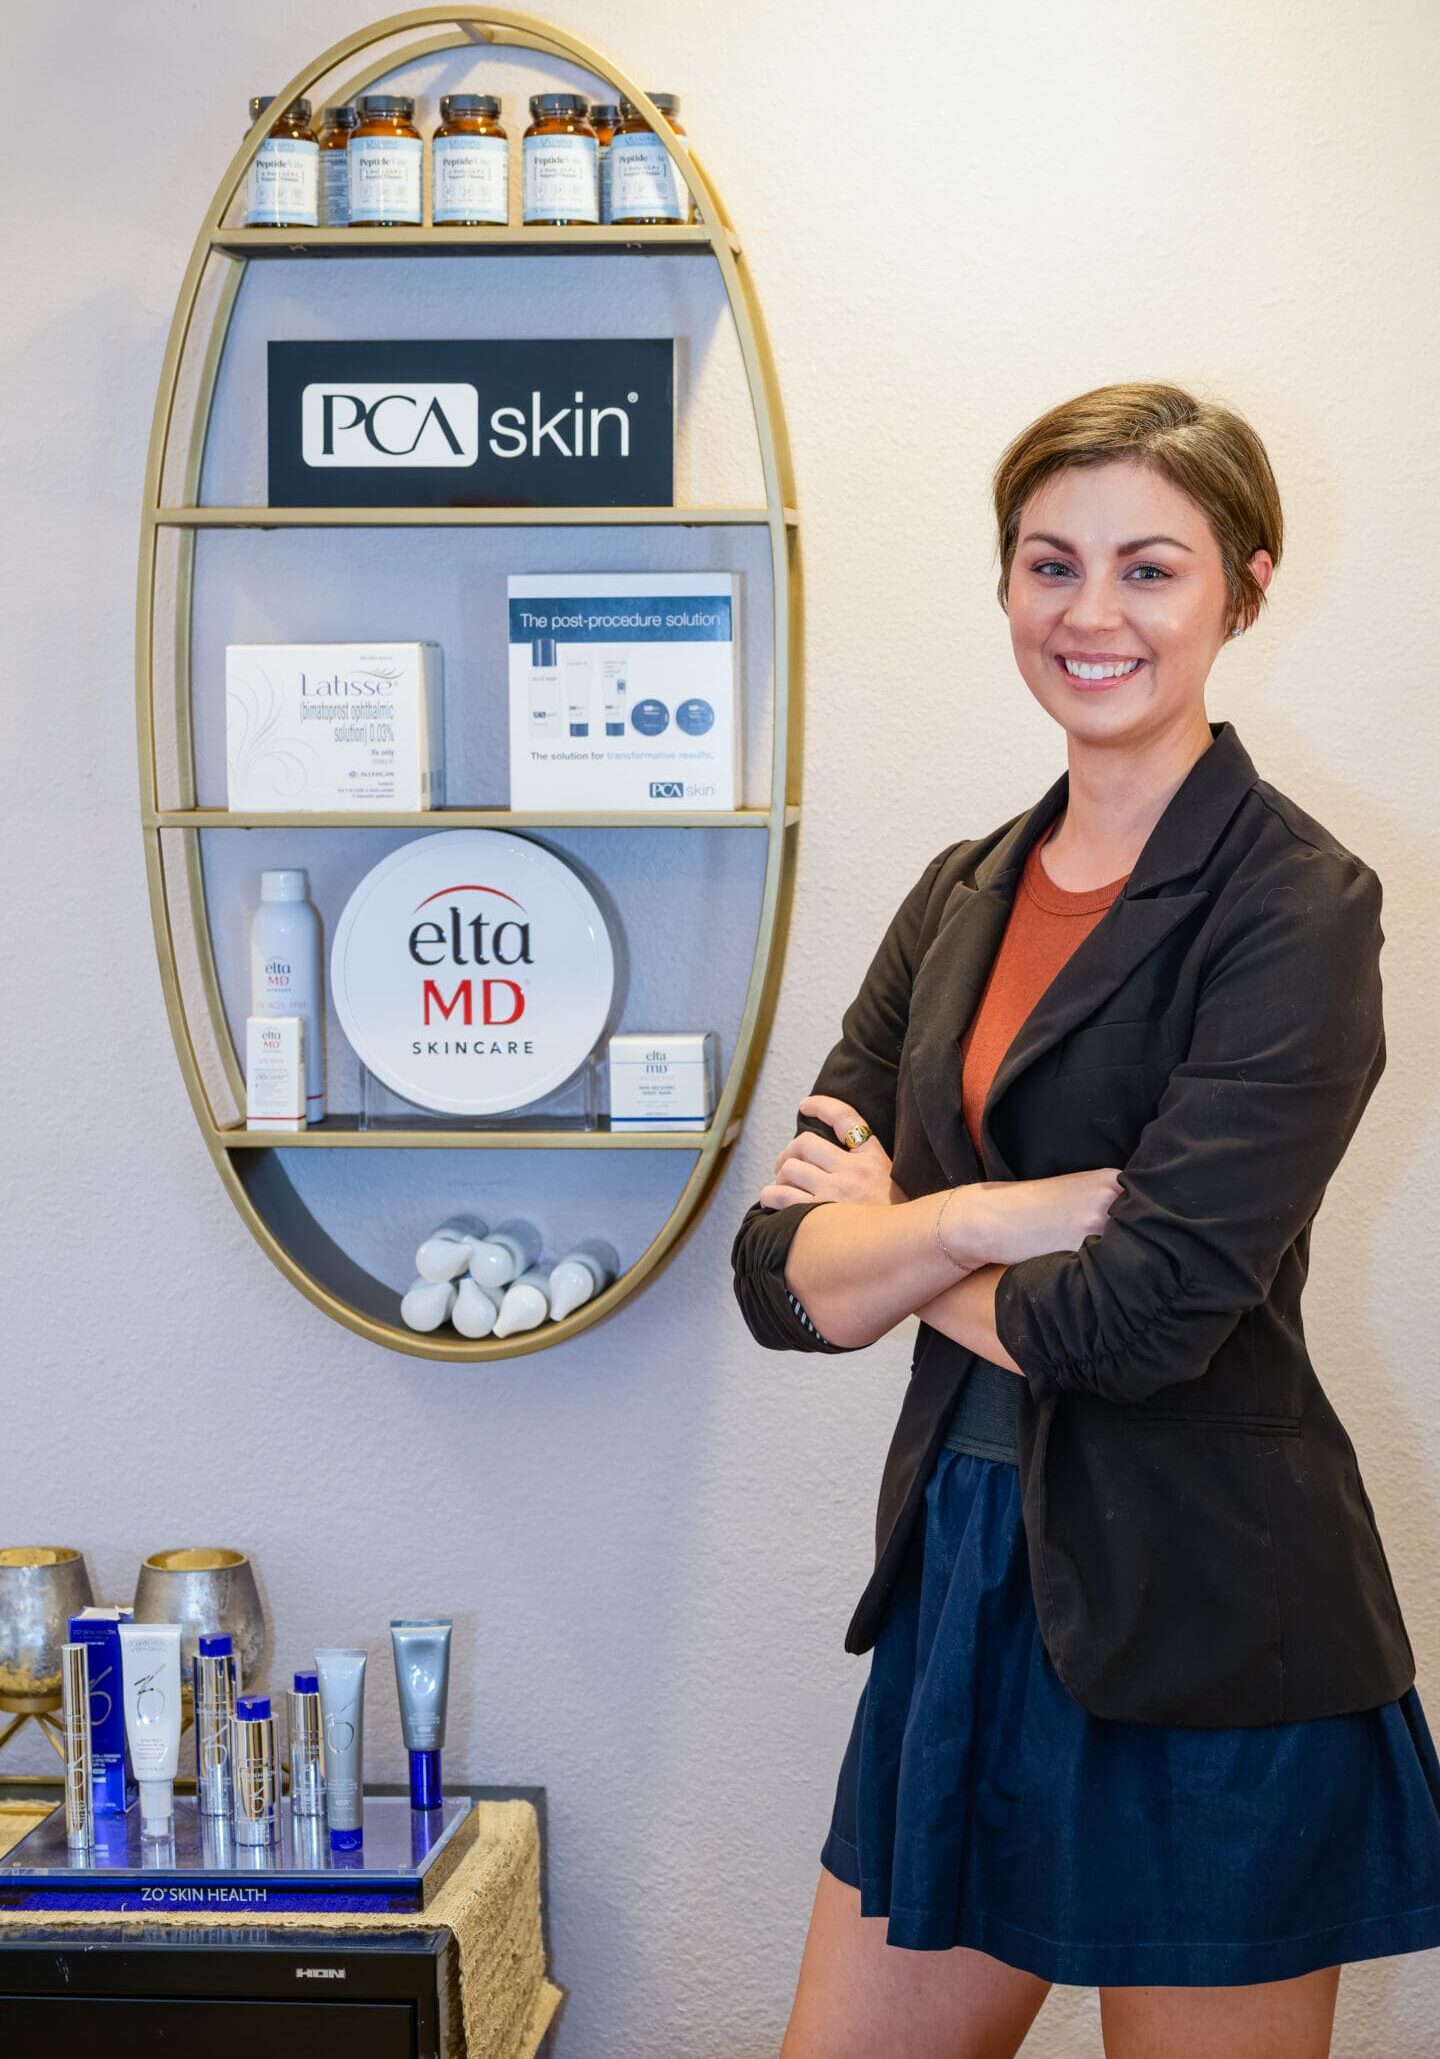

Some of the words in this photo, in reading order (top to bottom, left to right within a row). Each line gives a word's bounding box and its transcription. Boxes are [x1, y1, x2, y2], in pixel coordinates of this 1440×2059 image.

[321, 394, 465, 456] PCA
[519, 613, 548, 628] The
[551, 612, 662, 630] post-procedure
[665, 611, 721, 627] solution
[530, 751, 549, 761] The
[550, 751, 589, 761] solution
[591, 751, 604, 761] for
[652, 782, 683, 798] PCA
[408, 906, 535, 967] elta
[265, 962, 291, 974] elta
[267, 976, 290, 986] MD
[422, 979, 526, 1026] MD
[262, 1030, 281, 1041] elta
[412, 1041, 535, 1054] SKINCARE
[645, 1050, 667, 1061] elta
[168, 1888, 204, 1902] SKIN
[207, 1888, 267, 1902] HEALTH
